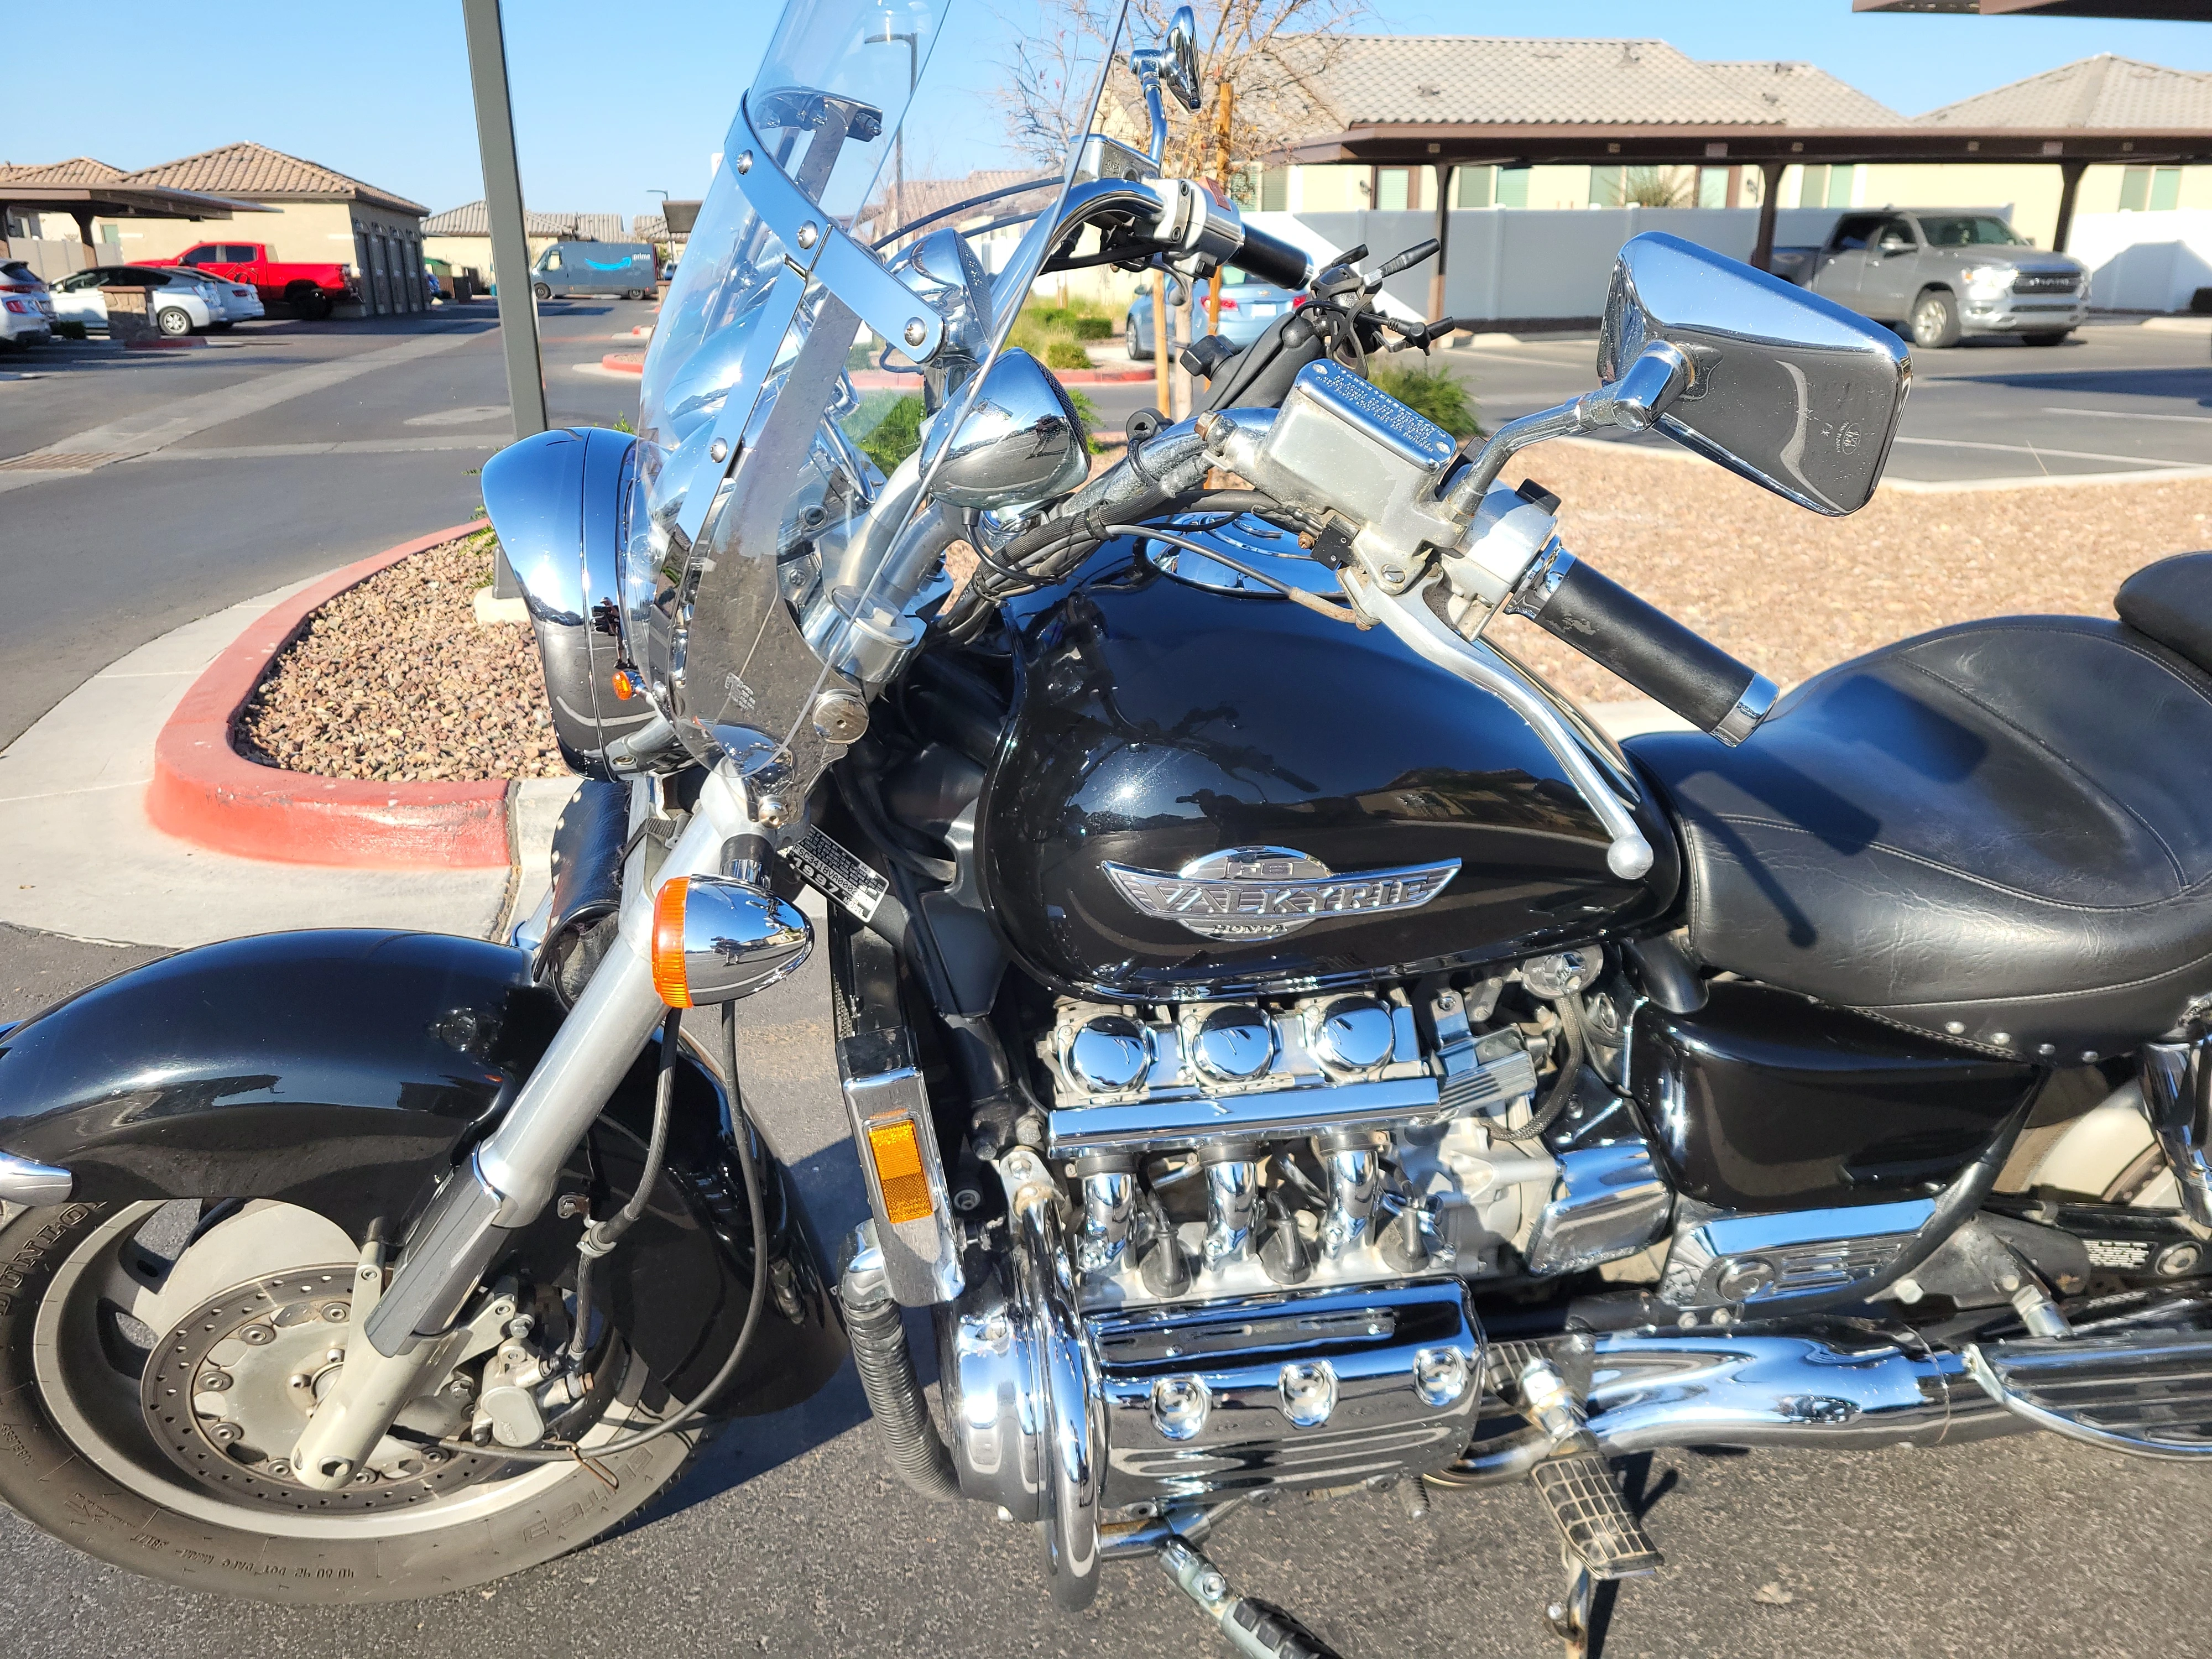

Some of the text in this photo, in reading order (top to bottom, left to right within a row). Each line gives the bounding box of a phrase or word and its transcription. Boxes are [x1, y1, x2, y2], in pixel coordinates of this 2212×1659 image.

[1104, 159, 1121, 170] LOWER
[633, 252, 651, 261] prime
[1402, 431, 1434, 453] WARNING
[1414, 434, 1431, 446] FROM
[792, 844, 869, 902] FSC3418VA0002
[792, 857, 839, 893] 1997
[1133, 875, 1429, 916] VALKYRIE
[843, 896, 864, 916] MODEL
[1213, 924, 1288, 933] HONDA
[0, 1423, 35, 1468] TUBELESS
[262, 1563, 286, 1576] DOT
